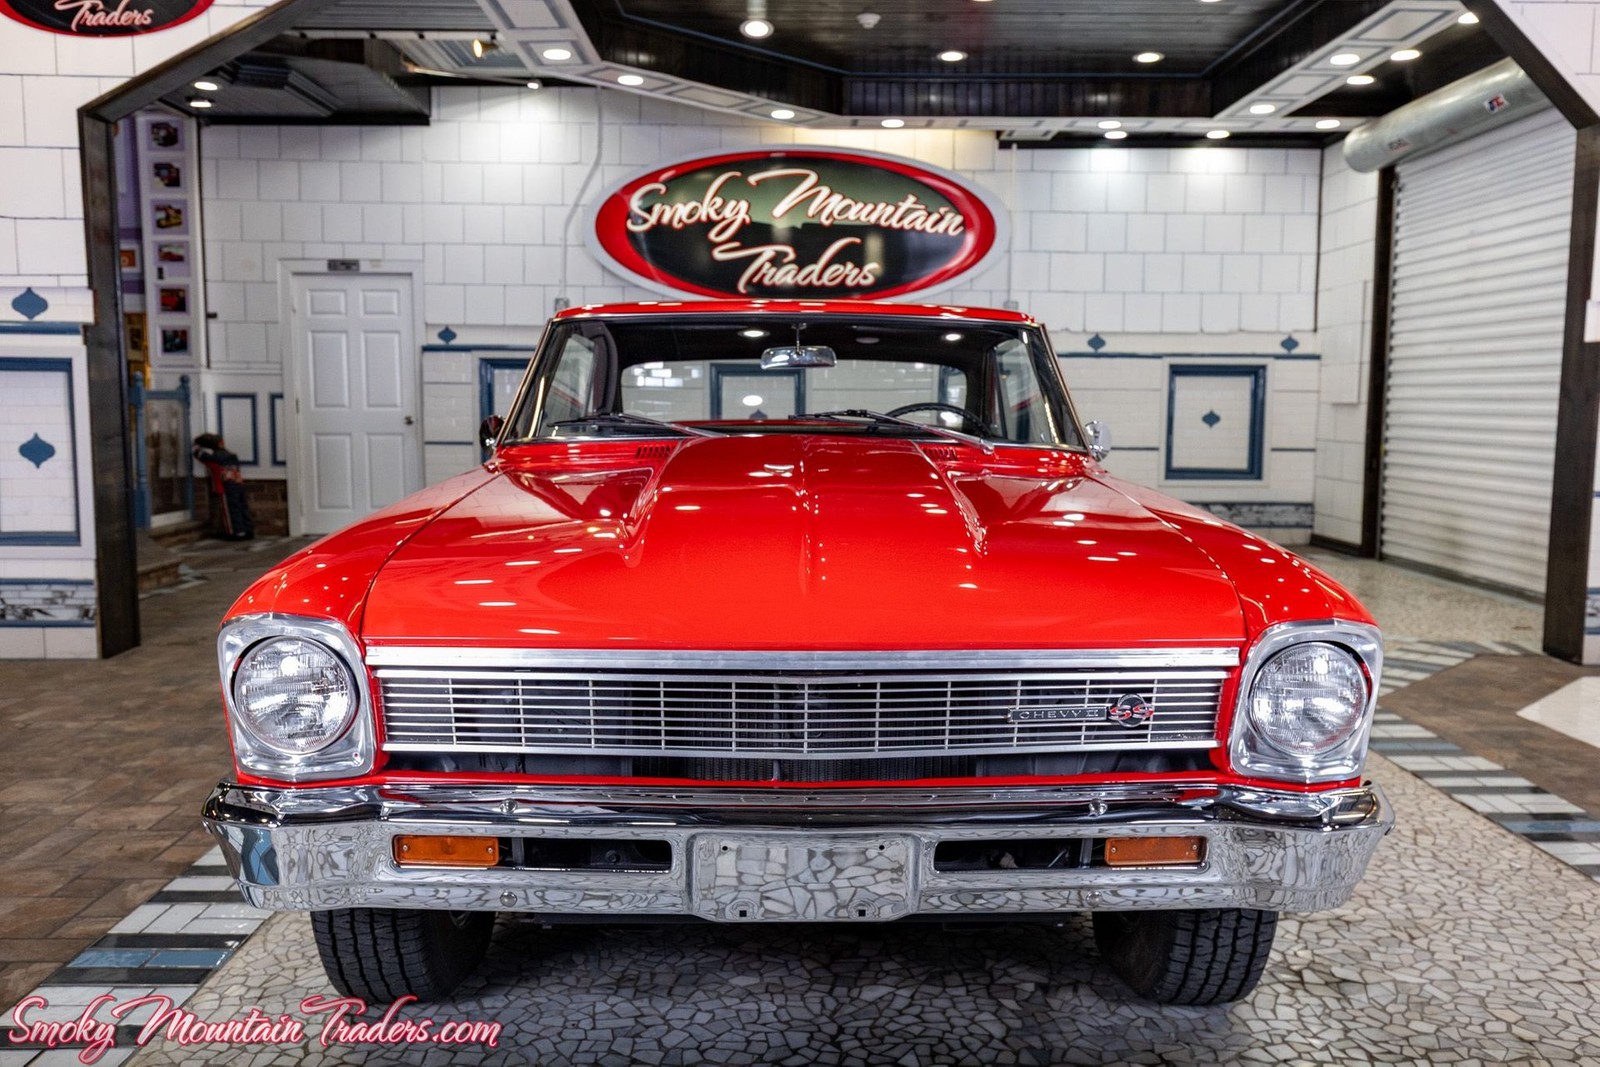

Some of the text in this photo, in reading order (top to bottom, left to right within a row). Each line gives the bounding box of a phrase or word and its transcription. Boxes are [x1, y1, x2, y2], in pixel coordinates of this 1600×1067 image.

[54, 0, 154, 32] Traders
[627, 168, 965, 242] Smoky Mountain
[713, 237, 880, 293] Traders
[1018, 709, 1082, 720] CHEVY
[1109, 703, 1155, 721] SS
